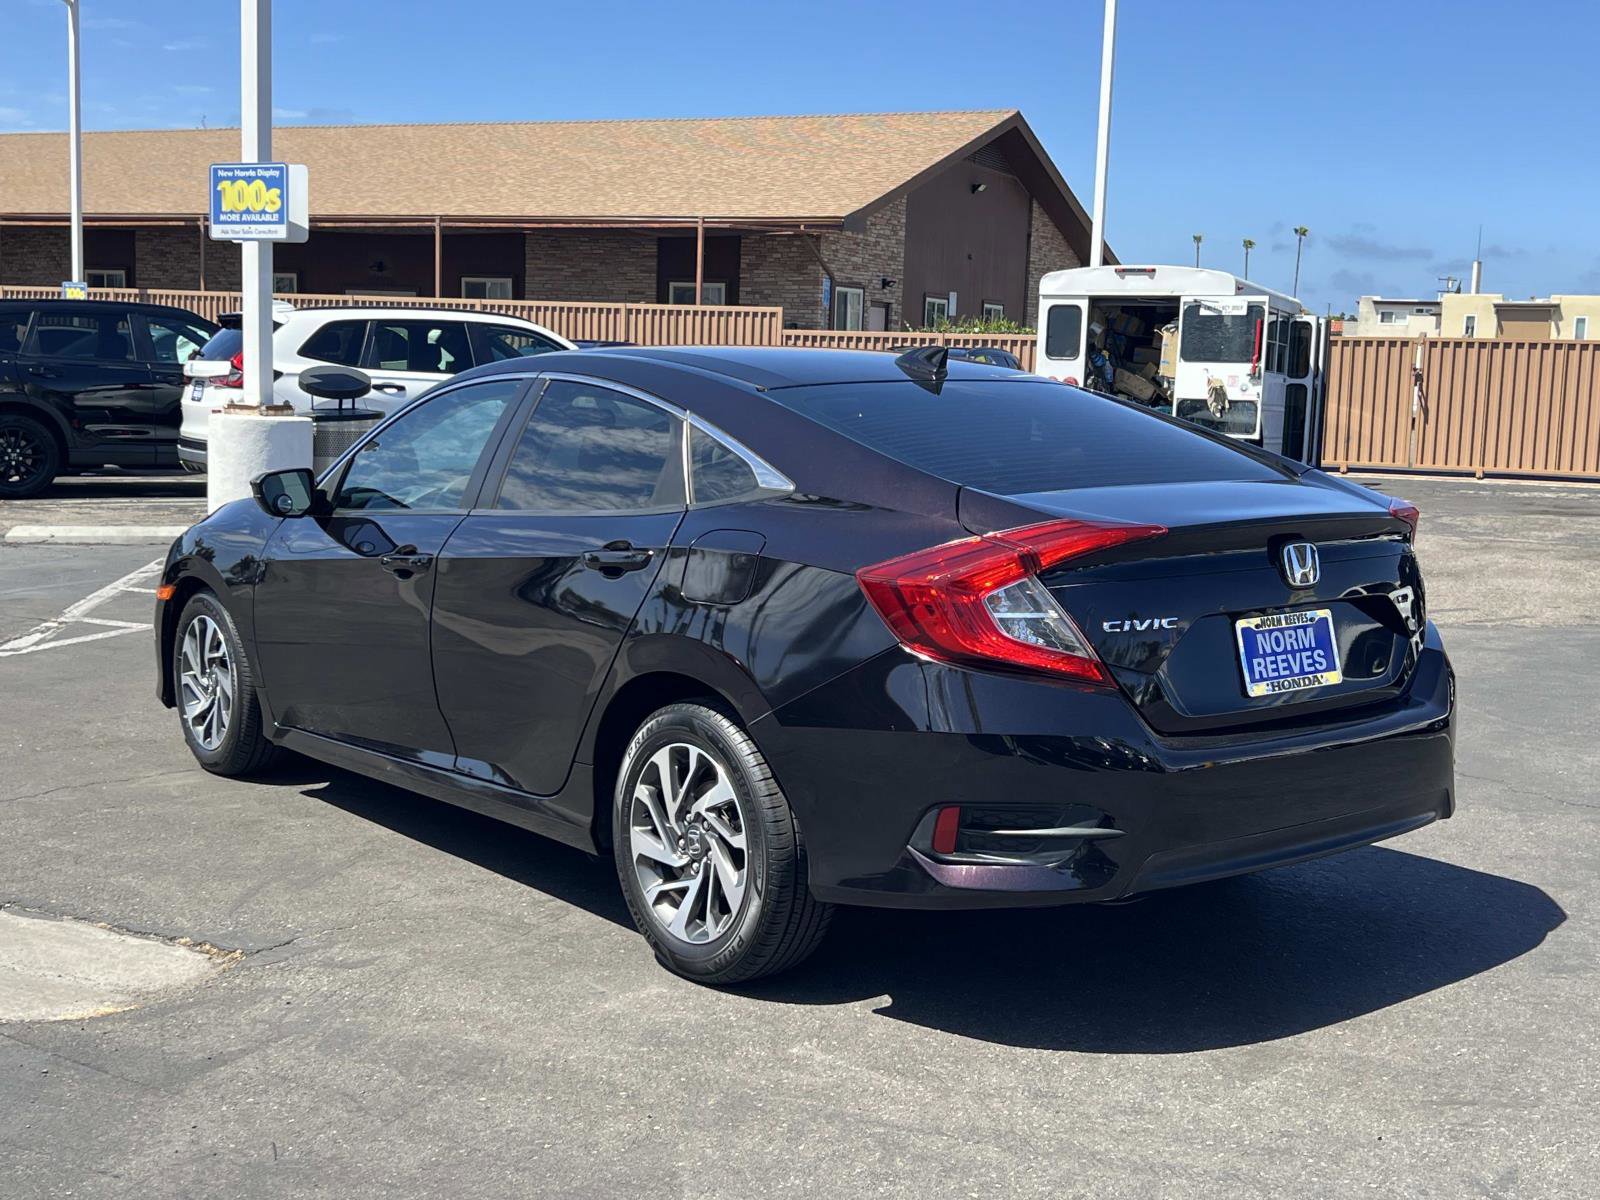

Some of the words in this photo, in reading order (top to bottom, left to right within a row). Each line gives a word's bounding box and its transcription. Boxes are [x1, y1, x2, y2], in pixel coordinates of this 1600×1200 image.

[218, 169, 233, 177] New
[234, 169, 256, 177] Honda
[257, 169, 280, 178] Display
[216, 179, 282, 212] 100s
[219, 213, 240, 221] MORE
[1102, 617, 1178, 632] CIVIC
[1260, 617, 1283, 629] NORM
[1284, 613, 1309, 626] REEVES
[1256, 628, 1316, 654] NORM
[1252, 650, 1327, 680] REEVES
